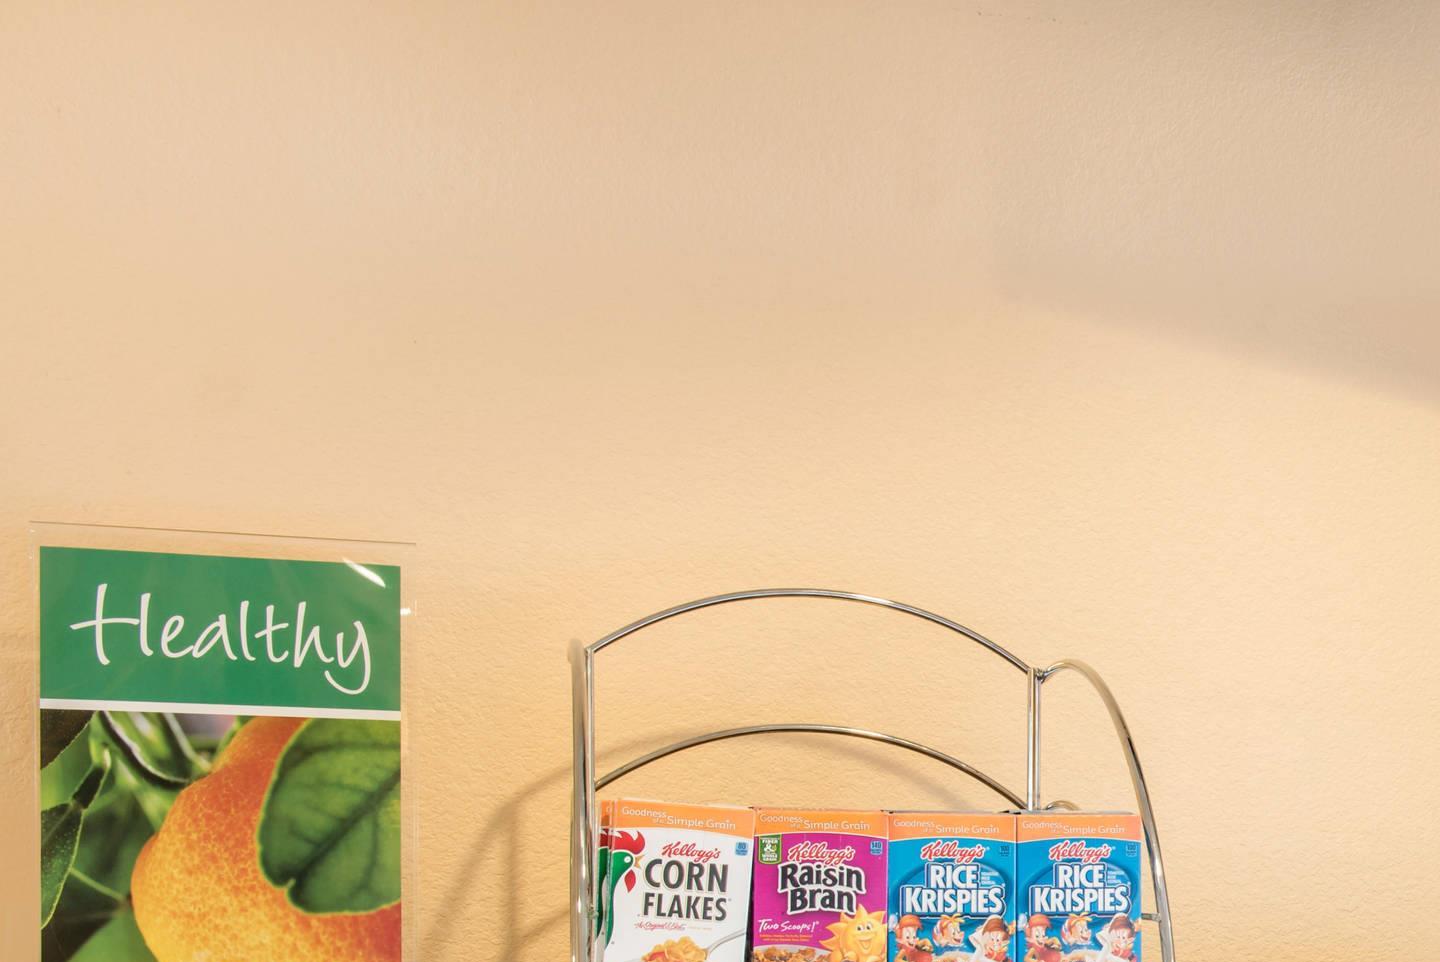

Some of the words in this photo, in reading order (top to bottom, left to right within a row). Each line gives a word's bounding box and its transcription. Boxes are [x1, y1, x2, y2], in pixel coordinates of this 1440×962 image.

[69, 582, 372, 695] Healthy
[622, 806, 667, 819] Goodness
[666, 815, 704, 828] Simple
[706, 818, 736, 831] Grain
[803, 821, 839, 830] Simple
[841, 820, 871, 830] Grain
[661, 841, 721, 863] Kellogg's
[788, 841, 855, 865] Kellogg's
[921, 841, 985, 864] Kellogg's
[1050, 841, 1111, 863] Kellogg's
[645, 858, 728, 893] CORN
[779, 862, 864, 892] Raisin
[930, 865, 978, 888] RICE
[1058, 864, 1105, 888] RICE
[643, 892, 727, 921] FLAKES
[789, 887, 855, 913] Bran
[905, 887, 1003, 913] KRISPIES
[1034, 887, 1128, 912] KRISPIES
[758, 918, 779, 932] Two
[781, 920, 816, 933] Scoops!
